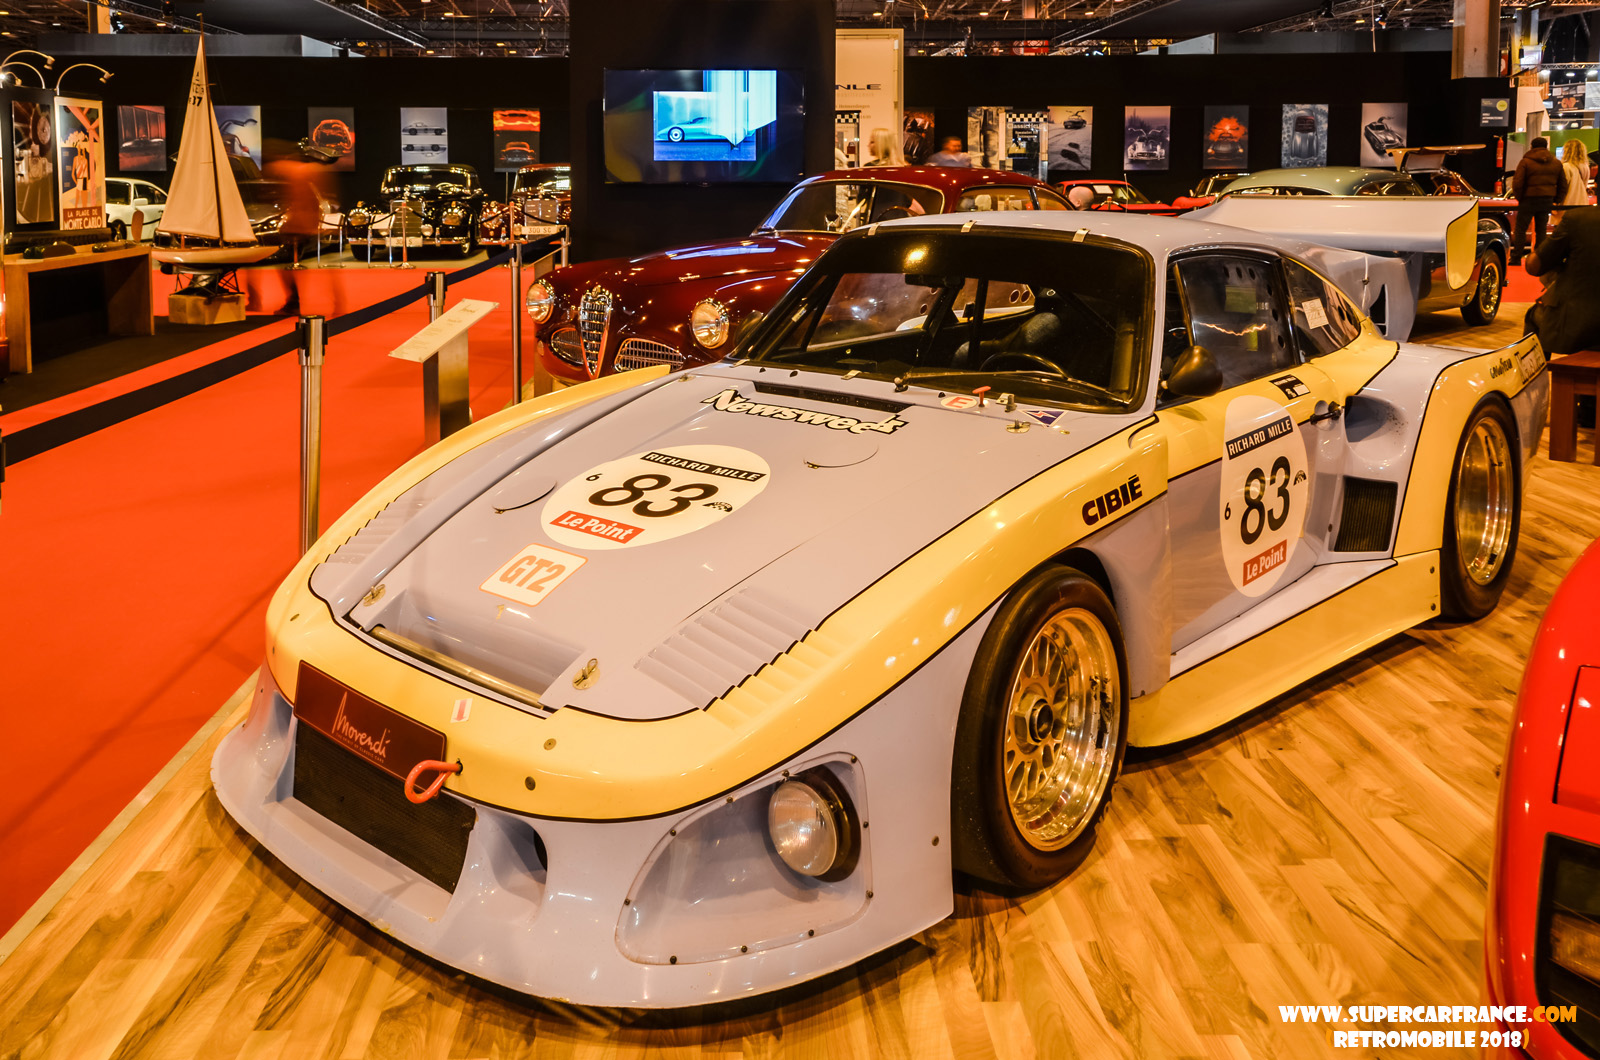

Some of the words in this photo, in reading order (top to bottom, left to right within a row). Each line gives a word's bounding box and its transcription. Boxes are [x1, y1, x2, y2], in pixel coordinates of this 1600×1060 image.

[63, 217, 83, 230] MONTE
[83, 216, 102, 229] CARLO
[76, 209, 90, 217] PLAGE
[528, 226, 541, 234] 300
[700, 388, 909, 435] Newsweek
[945, 396, 974, 409] E
[1228, 430, 1266, 456] RICHARD
[1267, 419, 1292, 439] MILLE
[585, 473, 603, 482] 6
[645, 453, 710, 472] RICHARD
[711, 467, 761, 481] MILLE
[588, 473, 719, 518] 83
[1081, 473, 1143, 526] CIBIÉ
[1240, 455, 1291, 545] 83
[1224, 501, 1232, 520] 6
[558, 513, 584, 528] Le
[578, 518, 635, 540] Point
[499, 555, 567, 593] GT2
[1246, 562, 1259, 581] Le
[1258, 544, 1284, 574] Point
